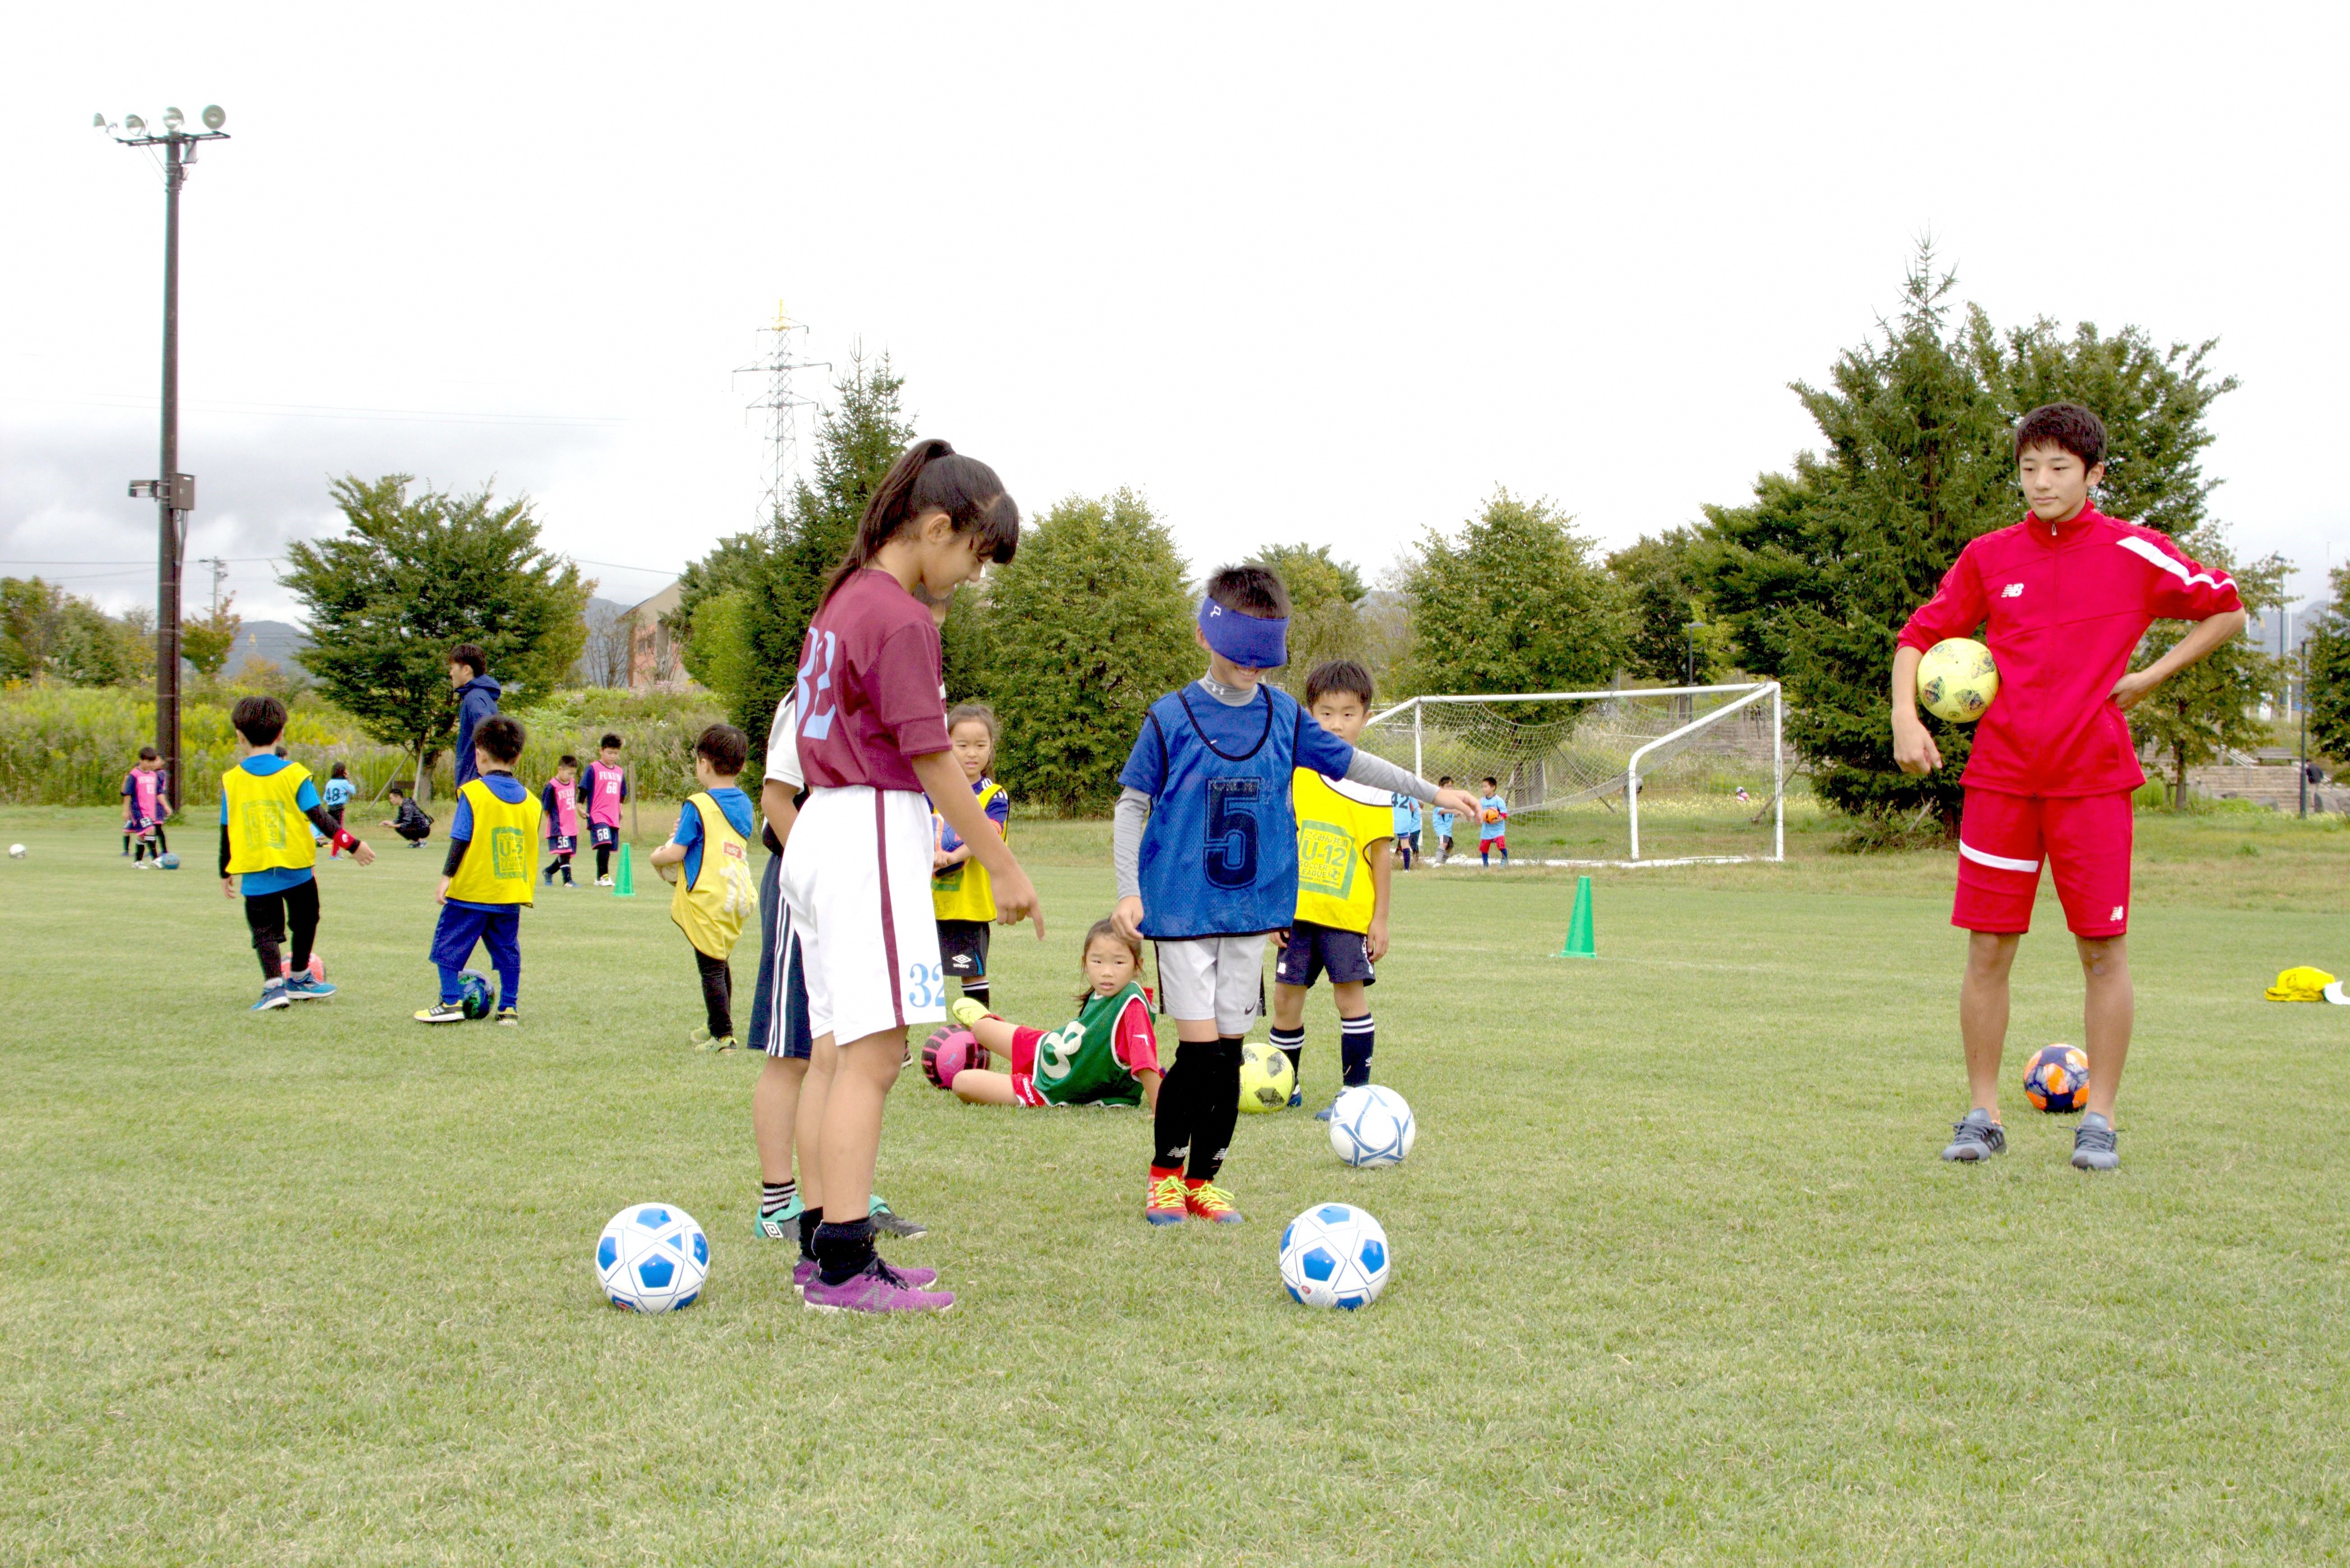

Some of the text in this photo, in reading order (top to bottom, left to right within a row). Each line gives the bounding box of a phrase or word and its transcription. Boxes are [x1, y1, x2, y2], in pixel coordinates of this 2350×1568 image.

[326, 787, 340, 802] 48
[606, 781, 618, 794] 68
[1391, 792, 1409, 810] 42
[597, 827, 609, 842] 68
[1203, 776, 1261, 891] 5
[500, 841, 523, 859] U-2
[557, 835, 569, 849] 56
[1301, 839, 1346, 867] U-12
[1299, 860, 1328, 871] SOCCER
[909, 962, 946, 1008] 32
